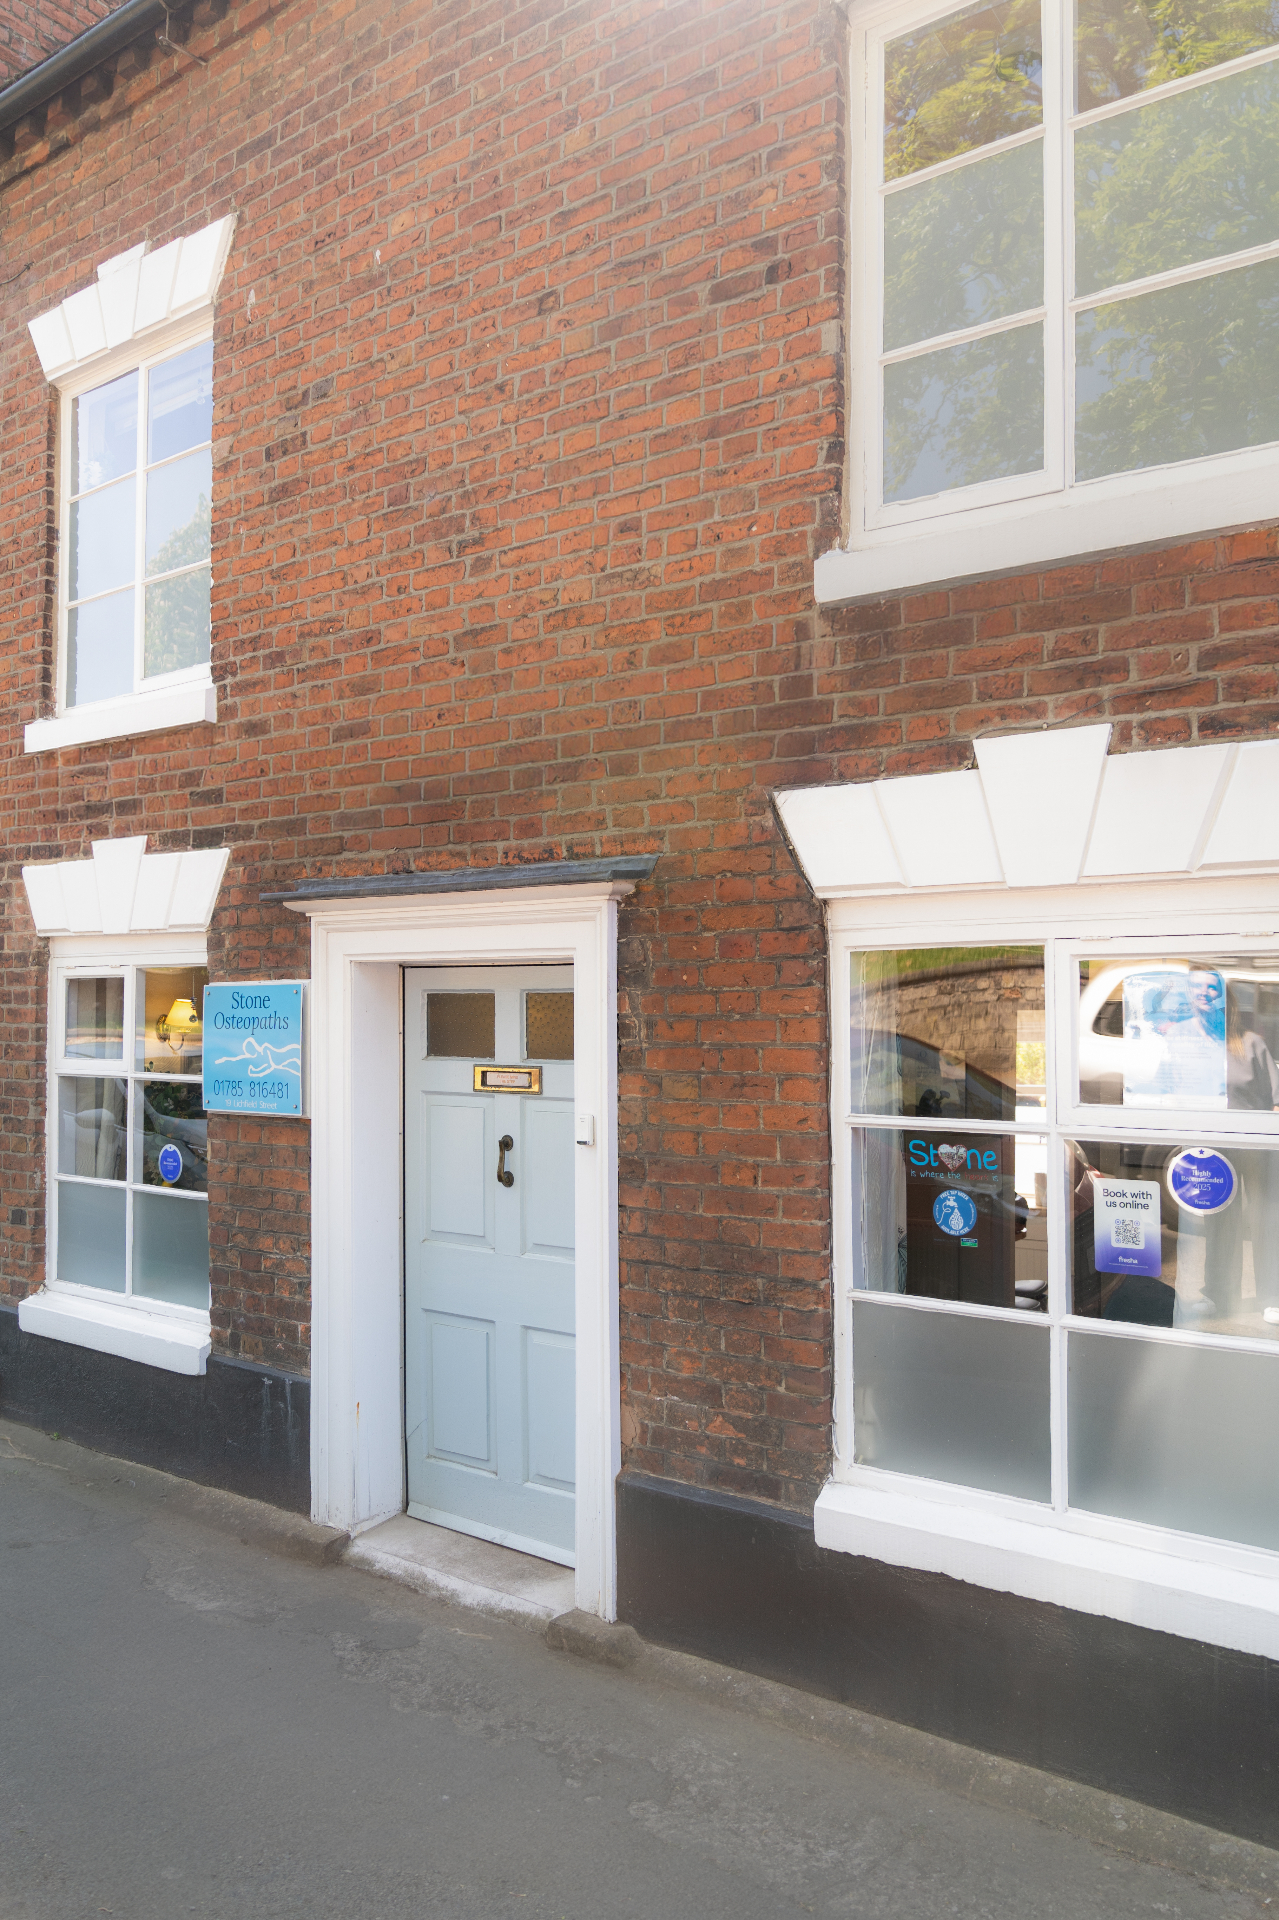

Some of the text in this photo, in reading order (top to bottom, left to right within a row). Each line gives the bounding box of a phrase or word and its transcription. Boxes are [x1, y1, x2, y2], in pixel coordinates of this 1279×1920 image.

[231, 991, 271, 1010] Stone
[214, 1010, 289, 1036] Osteopaths
[213, 1079, 289, 1100] 01785 816481
[225, 1099, 278, 1110] 19 Lichfield Street
[919, 1169, 945, 1179] where
[947, 1171, 961, 1180] the
[964, 1171, 989, 1181] heart
[991, 1172, 999, 1182] is
[1192, 1169, 1211, 1177] Highly
[1180, 1175, 1224, 1184] Recommended
[1193, 1183, 1212, 1191] 2025
[1102, 1188, 1153, 1200] Book with
[1119, 1200, 1150, 1210] online
[1118, 1255, 1138, 1264] fresha
